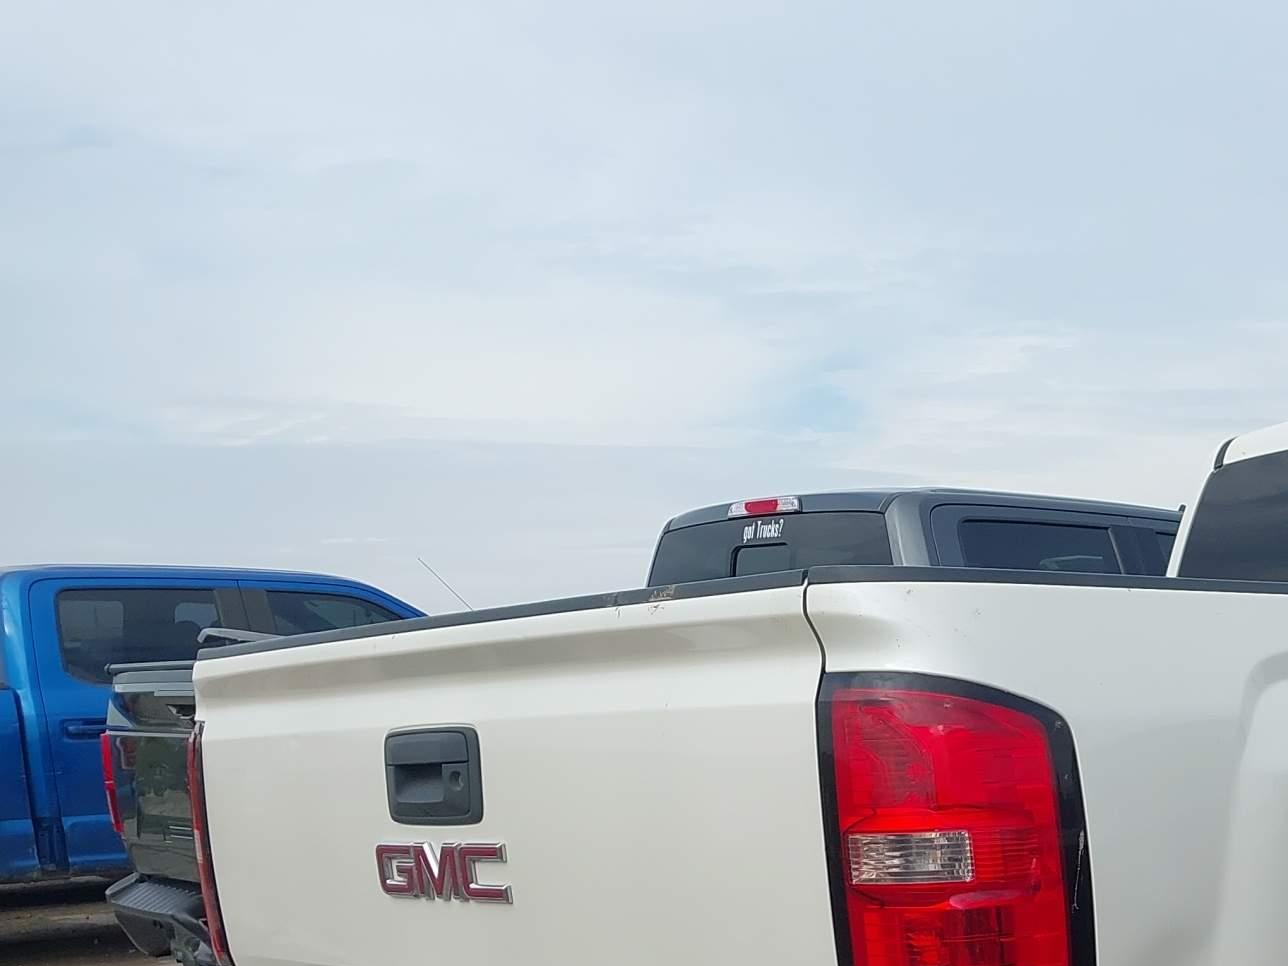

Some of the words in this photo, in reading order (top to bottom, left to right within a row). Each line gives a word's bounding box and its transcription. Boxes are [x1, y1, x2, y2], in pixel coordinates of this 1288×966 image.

[743, 522, 755, 544] got
[756, 519, 784, 539] Trucks?
[375, 841, 513, 904] GMC
